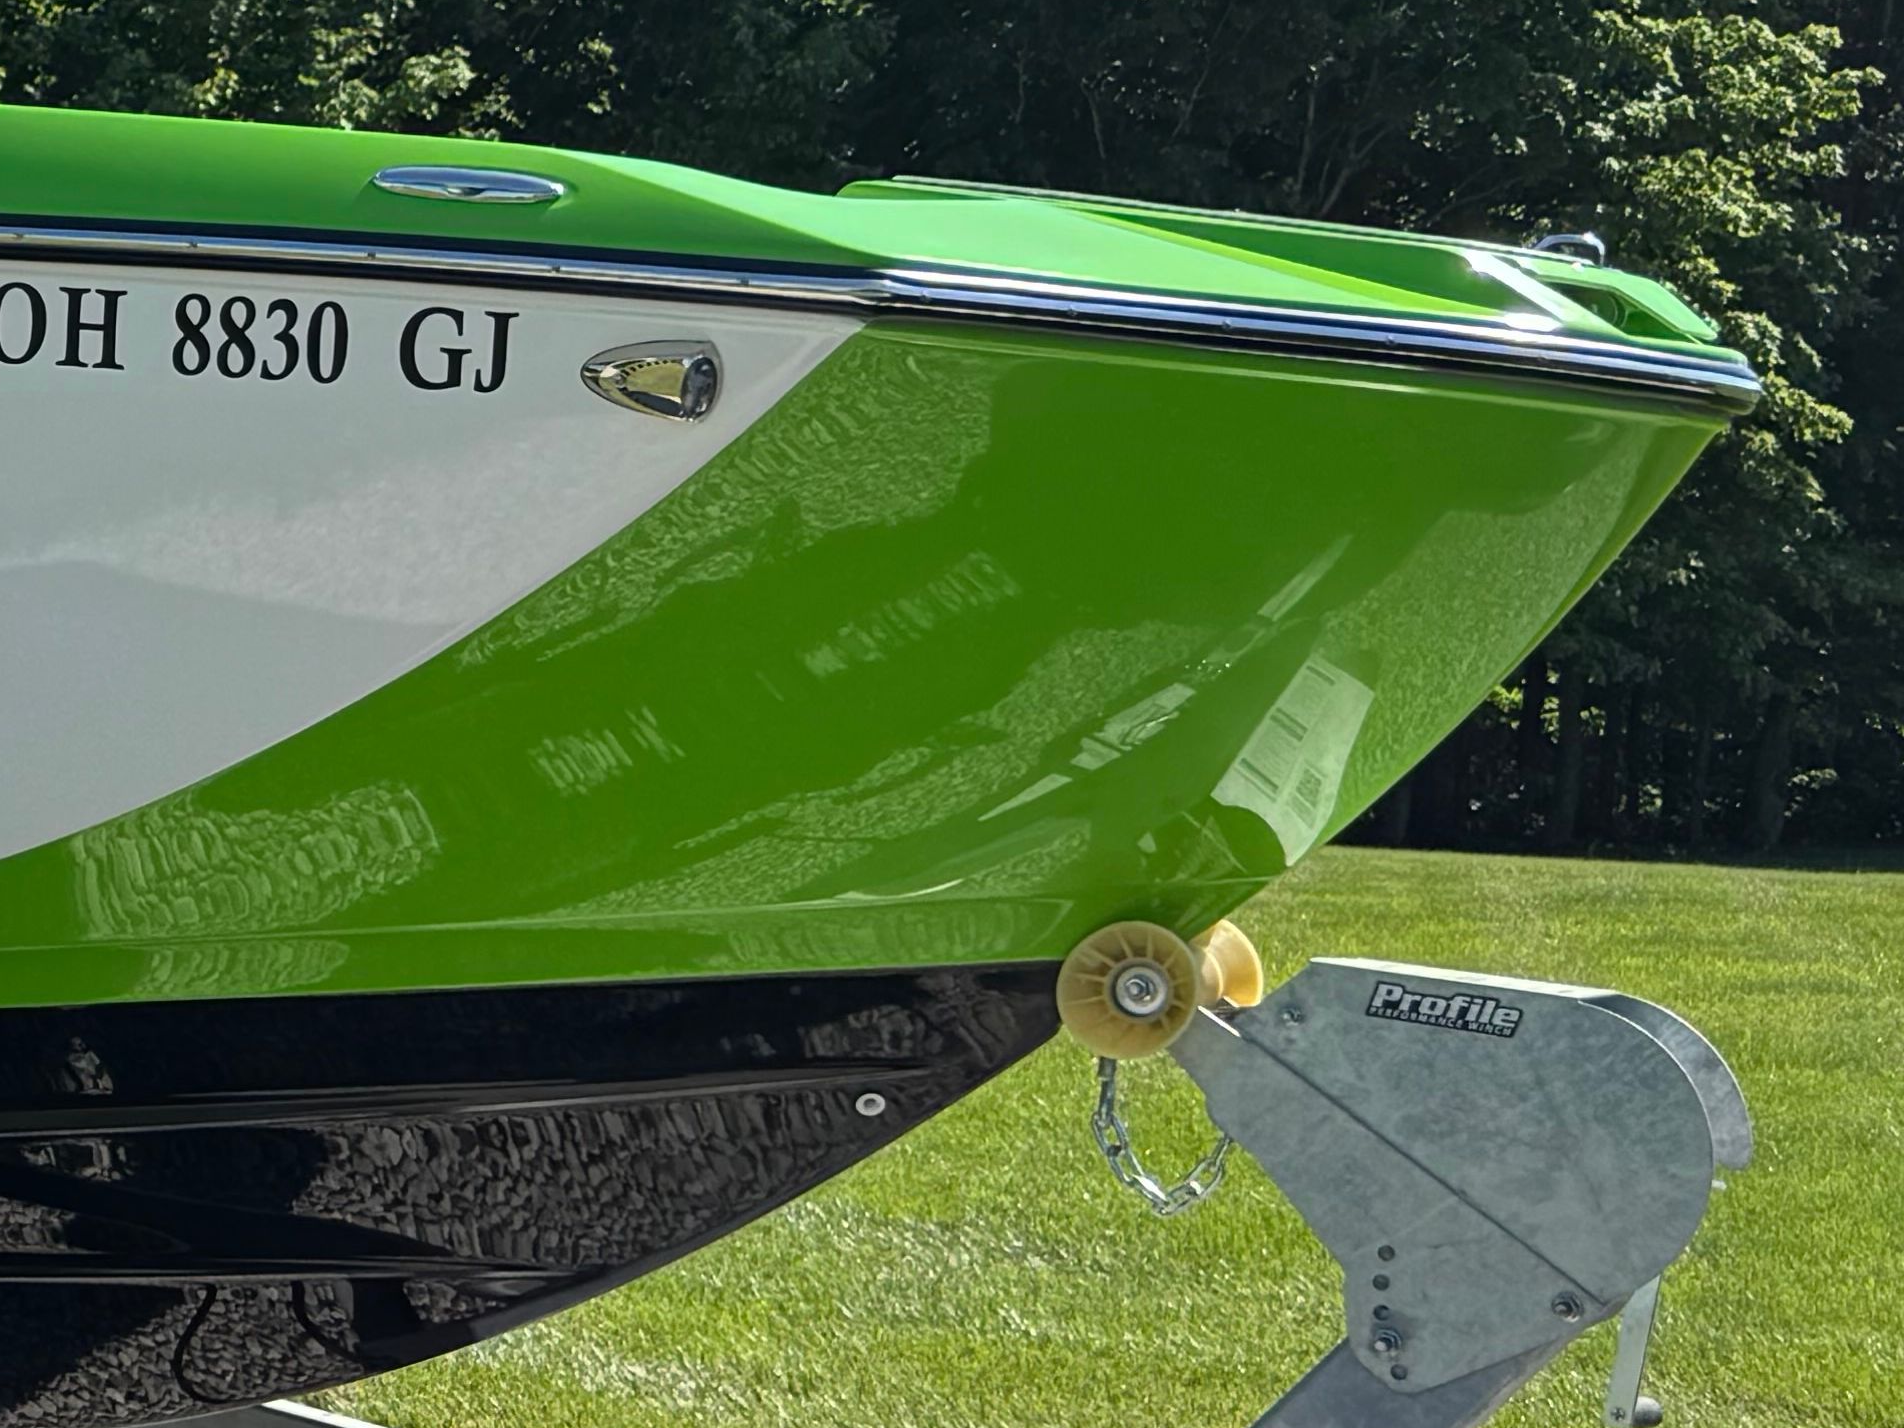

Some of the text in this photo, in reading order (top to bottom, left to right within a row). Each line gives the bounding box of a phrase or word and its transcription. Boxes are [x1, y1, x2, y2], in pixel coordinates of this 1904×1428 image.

[171, 293, 350, 384] 8830
[398, 306, 521, 394] GJ
[1368, 1006, 1513, 1037] PERFORMANCE WINCH
[1371, 983, 1521, 1028] Profile
